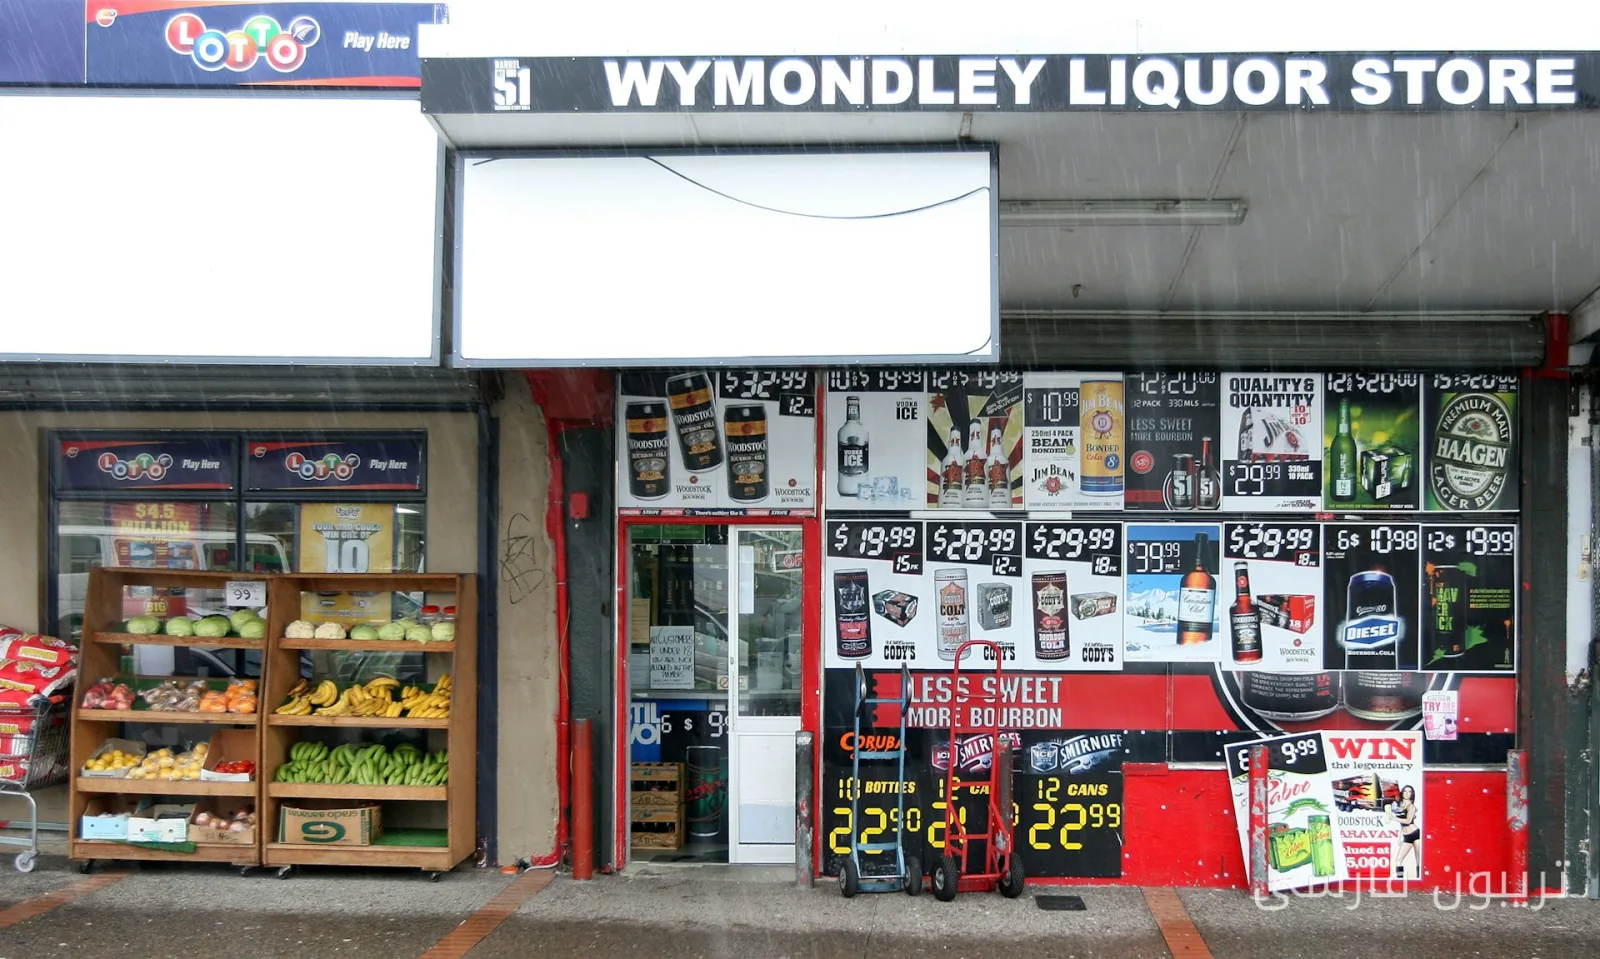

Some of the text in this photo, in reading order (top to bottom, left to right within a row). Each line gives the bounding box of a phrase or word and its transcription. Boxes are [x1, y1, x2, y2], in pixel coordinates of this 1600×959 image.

[176, 15, 300, 67] LOTTO
[344, 32, 410, 52] Play Here
[494, 68, 531, 107] 51
[603, 58, 1577, 109] WYMONDLEY LIQUOR STORE
[789, 397, 805, 414] 12
[1027, 391, 1079, 423] $ 10.99
[1142, 399, 1200, 408] PACK MLS
[1229, 393, 1316, 408] QUANTITY
[674, 407, 714, 425] WOODSTOCK
[896, 407, 918, 420] ICE
[1294, 405, 1306, 414] 10
[1131, 417, 1193, 431] LESS SWEET
[1294, 417, 1307, 426] 10
[1441, 398, 1510, 440] PREMIUM MALT
[1031, 430, 1074, 438] 250ml 4 PACK
[1131, 432, 1193, 443] MORE BOURBON
[628, 437, 668, 451] WOODSTOCK
[727, 439, 767, 453] WOODSTOCK
[1031, 438, 1074, 448] BEAM
[1086, 443, 1120, 453] BONDED
[103, 455, 165, 478] LOTTO
[182, 458, 220, 471] Play Here
[290, 455, 352, 477] LOTTO
[369, 458, 408, 471] Play Here
[844, 454, 863, 467] ICE
[1031, 464, 1075, 483] JIM BEAM
[1229, 465, 1281, 496] $ 29.99
[1296, 473, 1314, 482] PACK
[676, 485, 713, 494] WOODSTOCK
[774, 487, 811, 497] WOODSTOCK
[1433, 465, 1470, 510] LAGER
[1474, 474, 1504, 508] BEER
[135, 503, 176, 519] $4.5
[119, 520, 190, 534] MILLION
[322, 531, 340, 539] WIN
[933, 524, 1016, 561] $28.99
[1032, 524, 1115, 558] $29.99
[1229, 524, 1314, 558] $29.99
[1370, 526, 1418, 554] 10.98
[1466, 527, 1514, 556] 19.99
[326, 539, 369, 574] 10
[896, 554, 910, 572] 15
[1129, 542, 1181, 573] $ 39.99
[1298, 552, 1310, 566] 18
[995, 556, 1011, 574] 12
[1095, 556, 1111, 574] 18
[234, 588, 251, 600] 99
[1040, 595, 1062, 606] CODY'S
[146, 600, 167, 613] BIG
[940, 604, 966, 617] COLT
[1289, 618, 1302, 629] 18
[1346, 622, 1396, 642] DIESEL
[883, 645, 916, 661] CODY'S
[1040, 640, 1066, 651] COLA
[1279, 648, 1316, 657] WOODSTOCK
[1081, 647, 1115, 663] CODY'S
[910, 675, 1063, 704] LESS SWEET
[1423, 701, 1456, 712] TRY ME
[683, 717, 693, 732] $
[907, 707, 1062, 728] MORE BOURBON
[1060, 733, 1123, 763] SMIRNOFF
[1280, 739, 1318, 765] 9.99
[1328, 738, 1417, 760] WIN
[1331, 761, 1414, 771] the legendary
[839, 776, 861, 801] 10
[1038, 777, 1109, 802] 12 CANS
[1029, 803, 1088, 850] 22
[1340, 829, 1400, 839] ARAVAN
[1376, 847, 1390, 855] at
